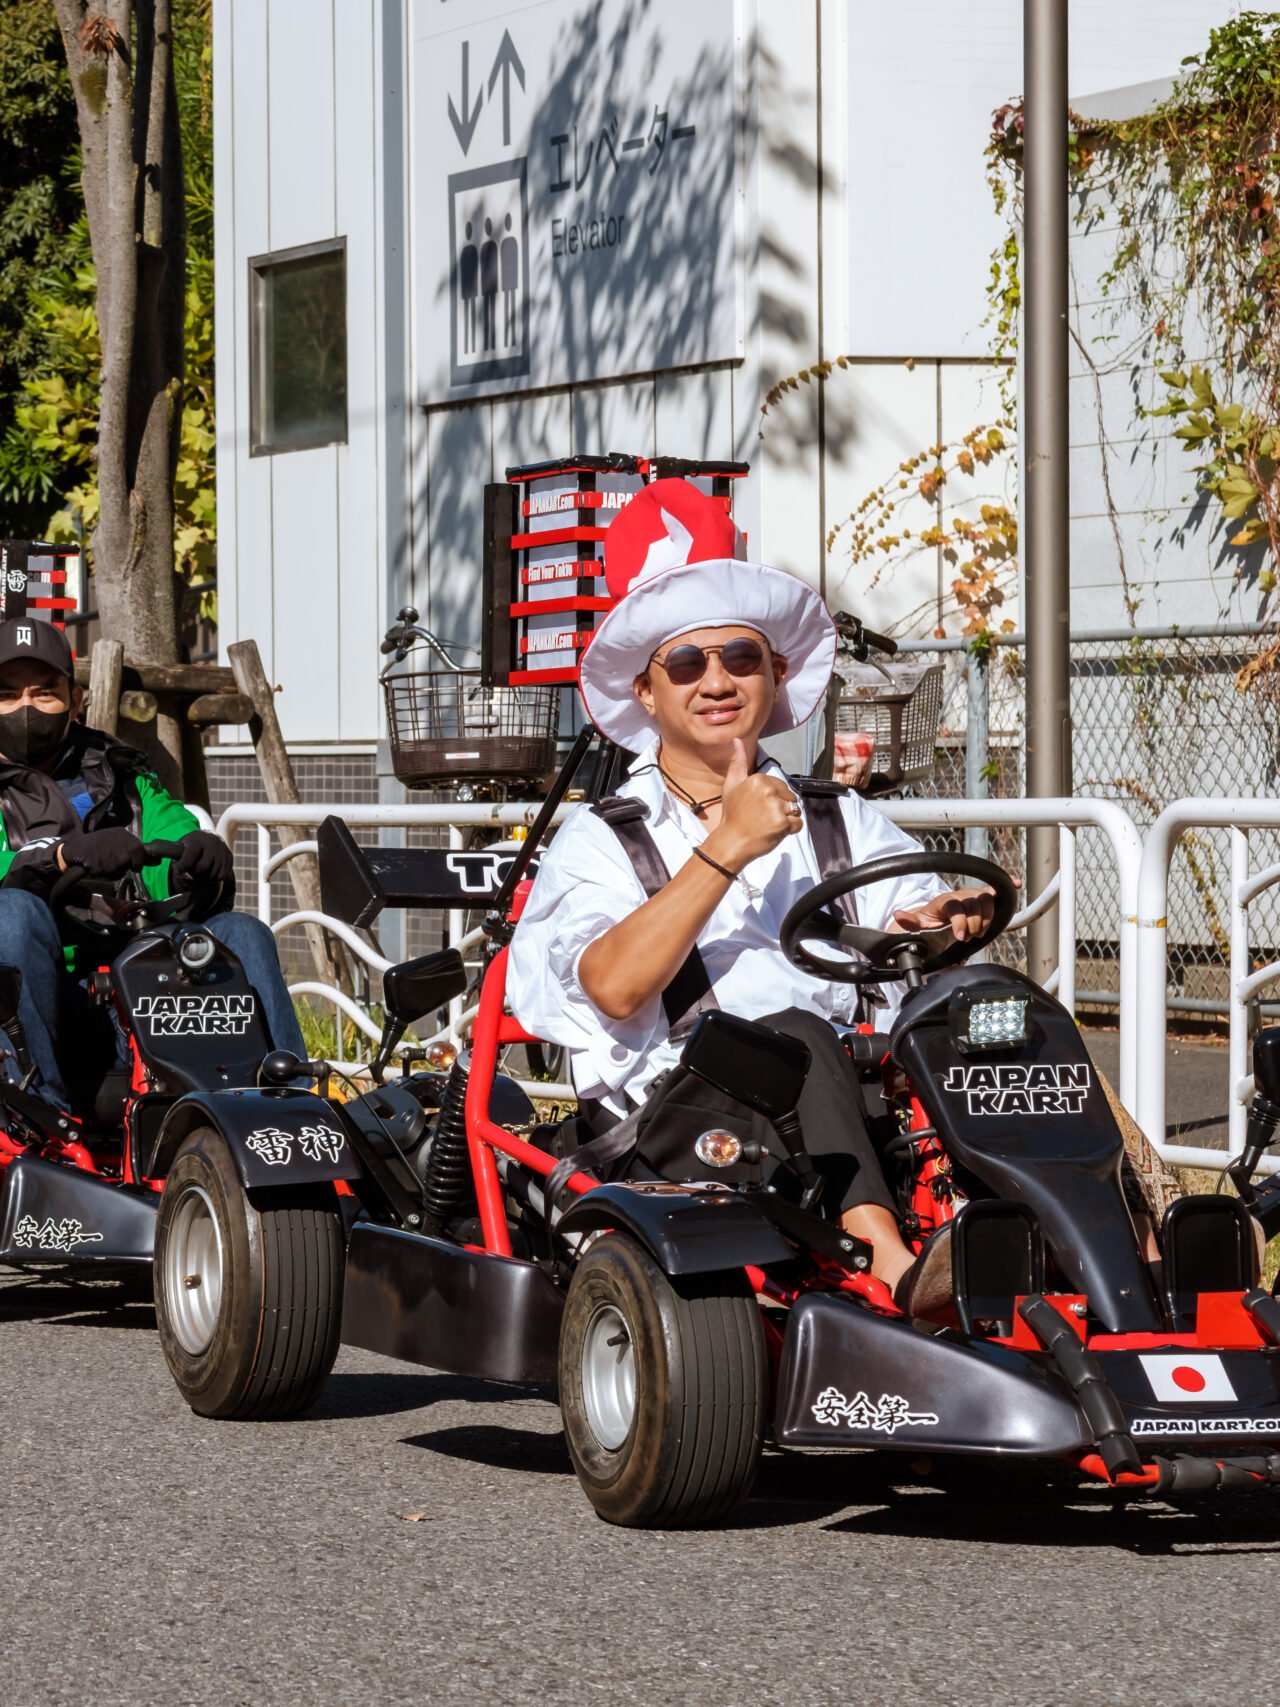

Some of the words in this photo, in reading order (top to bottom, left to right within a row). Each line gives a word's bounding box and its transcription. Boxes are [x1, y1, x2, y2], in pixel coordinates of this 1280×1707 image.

[549, 104, 696, 193] エレベーター
[551, 213, 625, 257] Elevator
[133, 995, 254, 1017] JAPAN
[150, 1014, 251, 1035] KART
[944, 1063, 1091, 1092] JAPAN
[967, 1088, 1088, 1116] KART
[246, 1125, 345, 1165] 雷神
[13, 1216, 104, 1252] 安全第一
[812, 1386, 940, 1435] 安全第一
[1131, 1418, 1197, 1435] JAPAN
[1198, 1416, 1280, 1433] KART.CO
